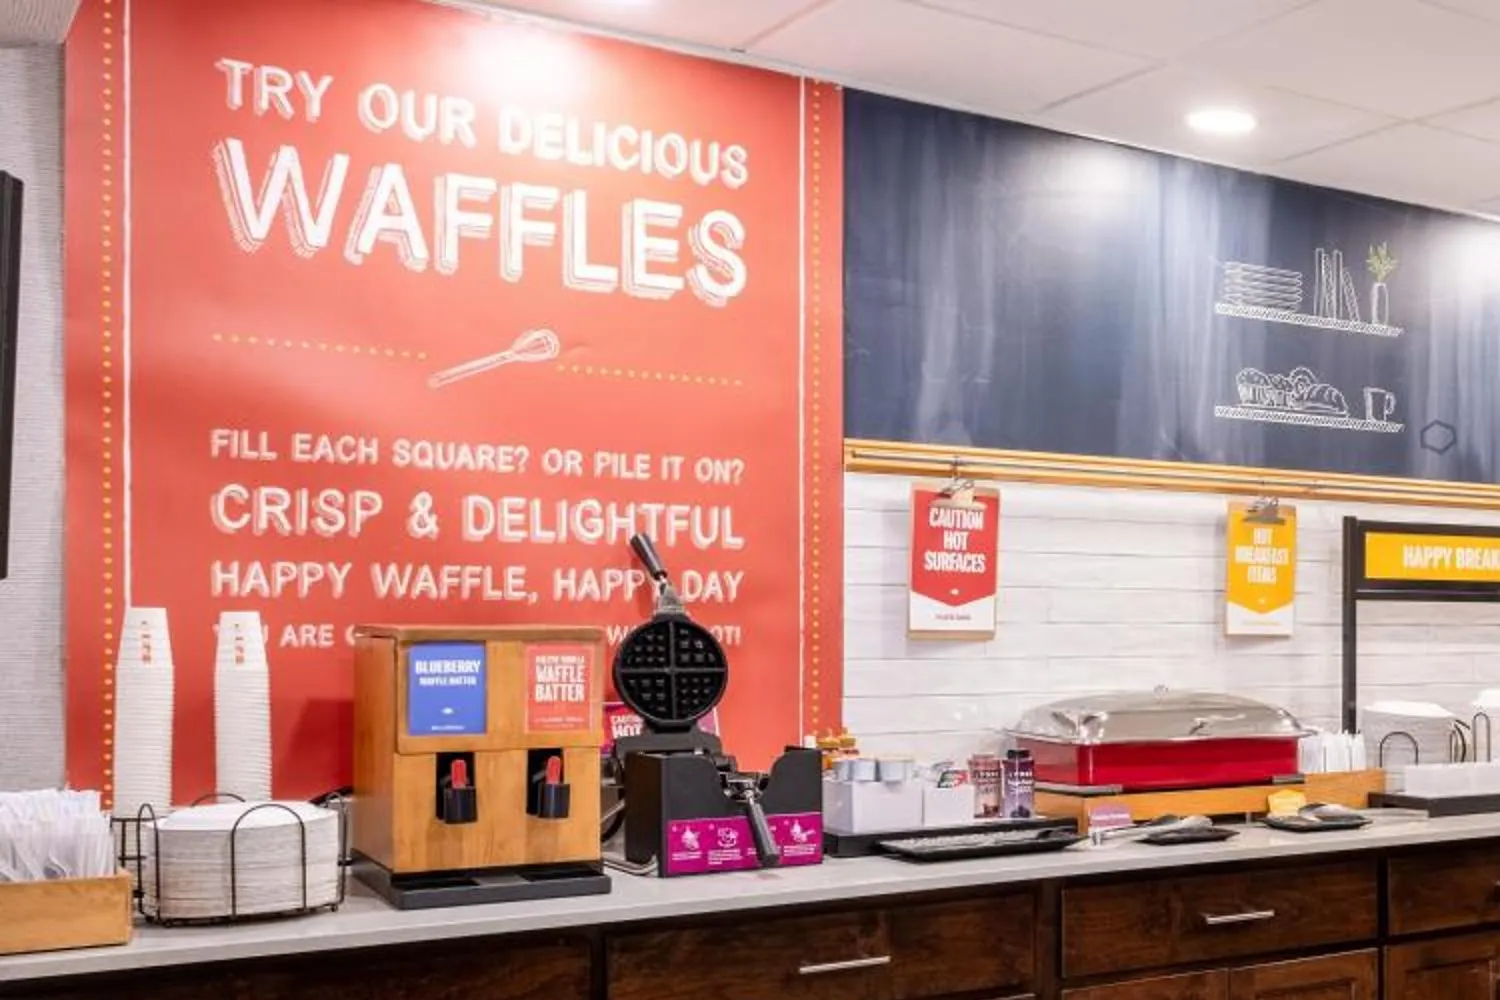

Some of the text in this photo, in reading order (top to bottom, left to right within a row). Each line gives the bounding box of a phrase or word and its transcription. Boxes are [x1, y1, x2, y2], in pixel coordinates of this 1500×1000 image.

[214, 57, 749, 189] TRY OUR DELICIOUS
[211, 137, 747, 308] WAFFLES
[210, 428, 745, 485] FILL EACH SQUARE? OR PILE IT ON?
[210, 483, 745, 550] CRISP & DELIGHTFUL
[929, 507, 984, 530] CAUTION
[943, 531, 969, 550] HOT
[924, 551, 986, 573] SURFACES
[1403, 545, 1453, 569] HAPPY
[210, 560, 352, 599] HAPPY
[370, 562, 539, 605] WAFFLE,
[680, 570, 745, 603] DAY
[280, 624, 334, 648] ARE
[415, 660, 481, 674] BLUEBERRY
[535, 665, 585, 683] WAFFLE
[535, 683, 585, 703] BATTER
